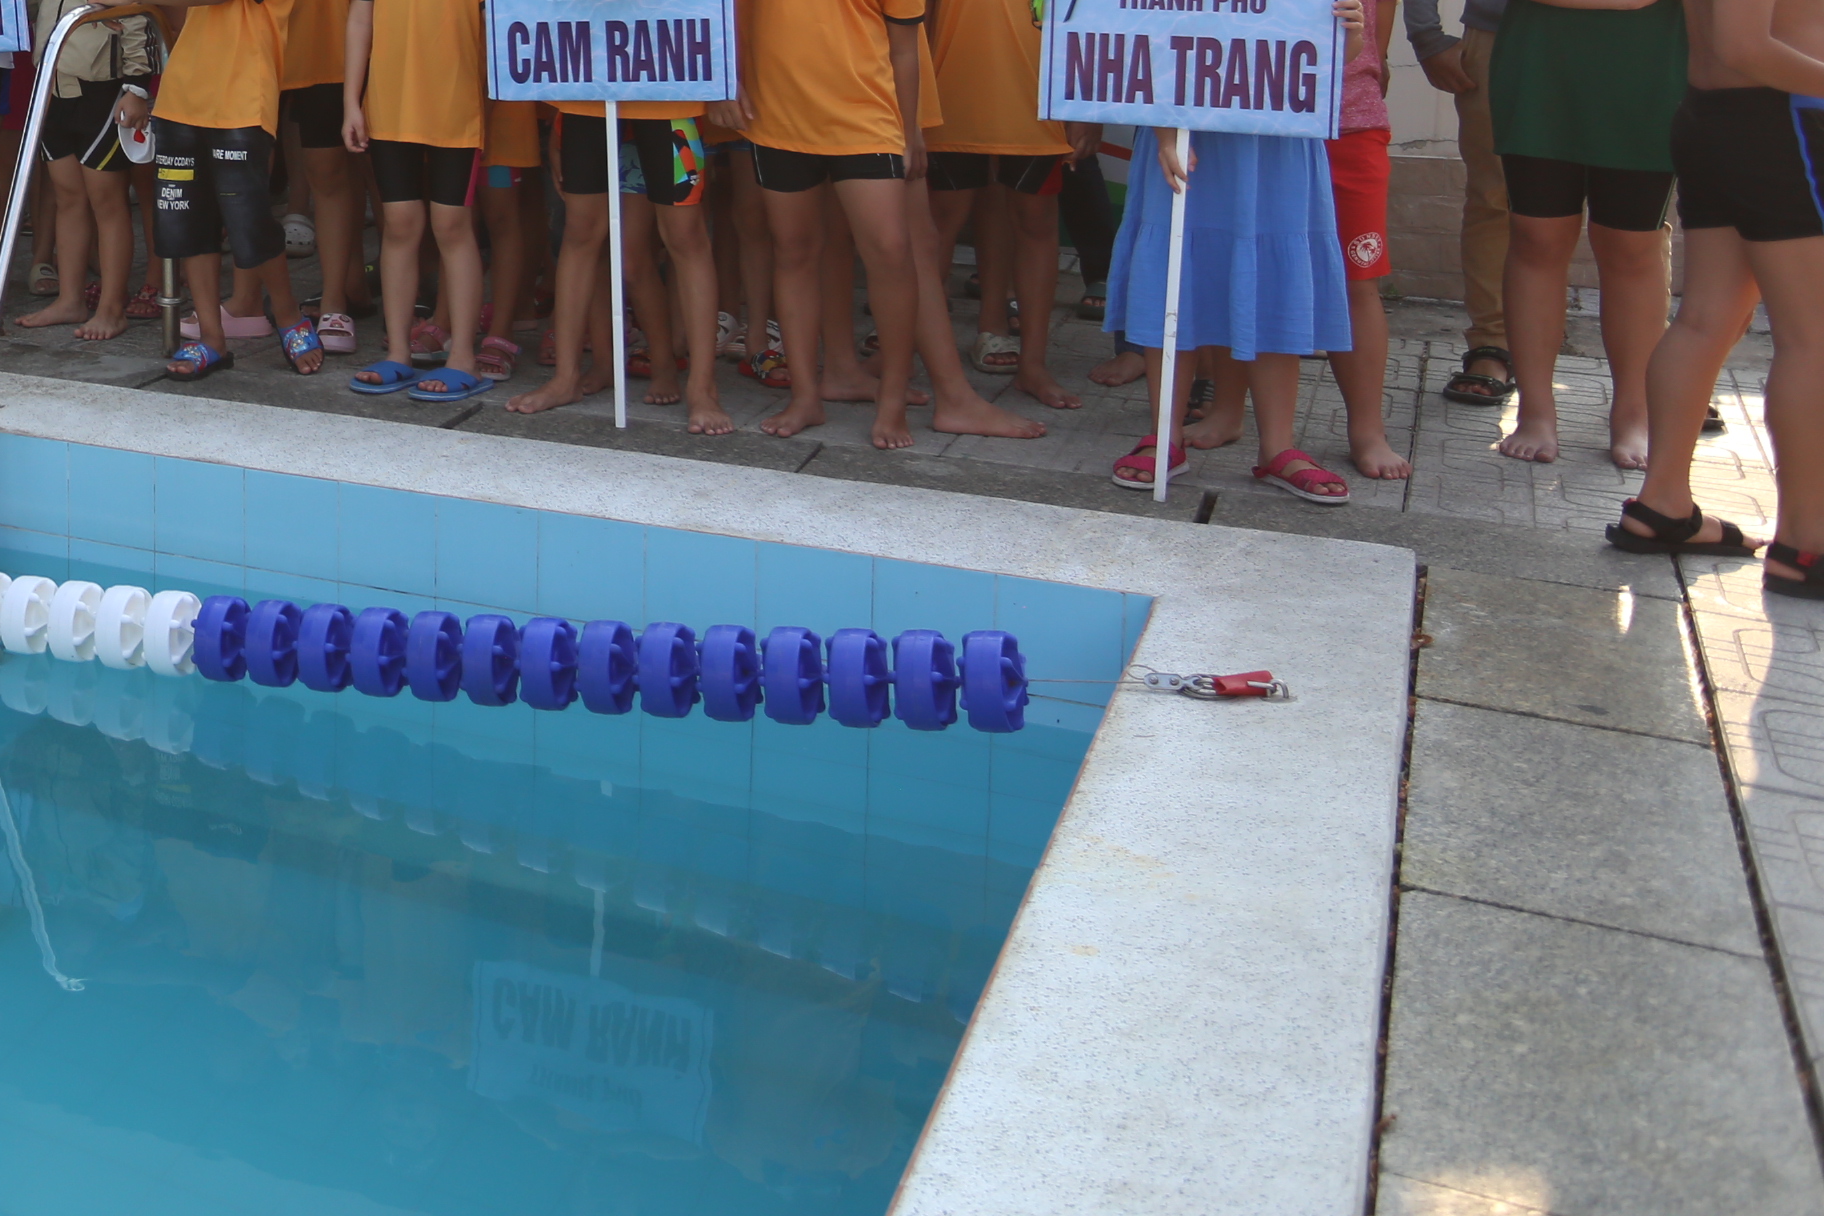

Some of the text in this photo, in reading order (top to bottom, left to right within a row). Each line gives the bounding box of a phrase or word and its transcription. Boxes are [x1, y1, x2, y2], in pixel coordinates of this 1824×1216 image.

[507, 18, 712, 84] CAM RANH
[1064, 31, 1317, 114] NHA TRANG
[161, 187, 183, 198] DENIM
[170, 200, 190, 210] YORK
